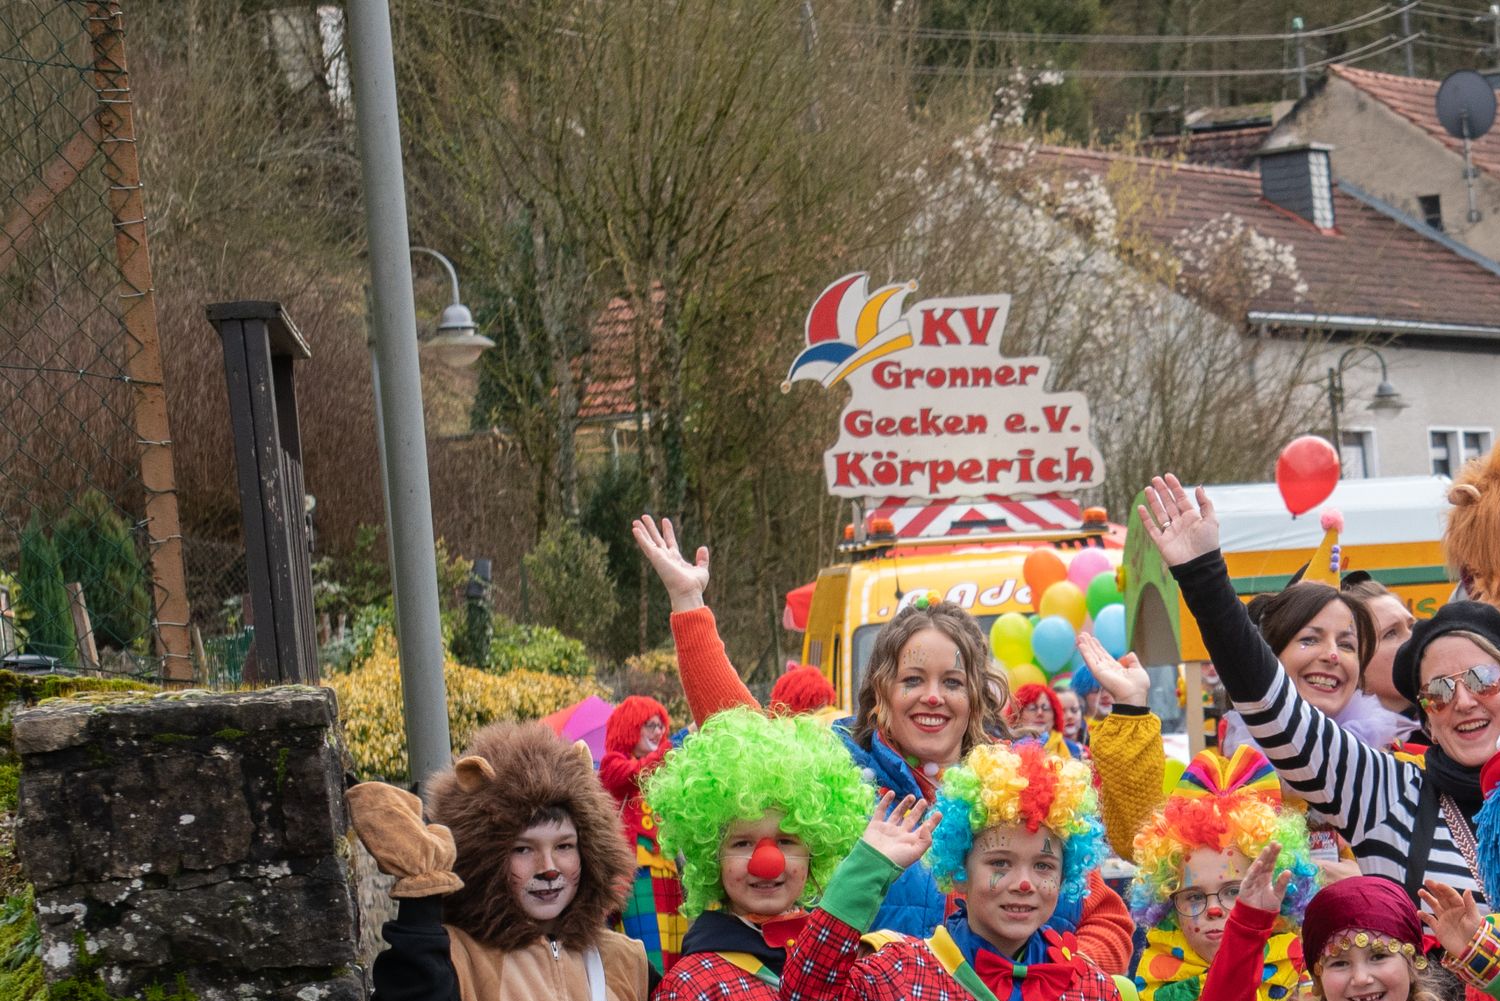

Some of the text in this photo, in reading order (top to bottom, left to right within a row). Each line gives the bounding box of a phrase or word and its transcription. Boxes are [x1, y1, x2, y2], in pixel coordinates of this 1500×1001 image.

[919, 306, 1000, 348] KV
[871, 360, 1040, 390] Gronner
[843, 405, 1082, 439] Gecken e.V.
[832, 447, 1096, 494] Körperich
